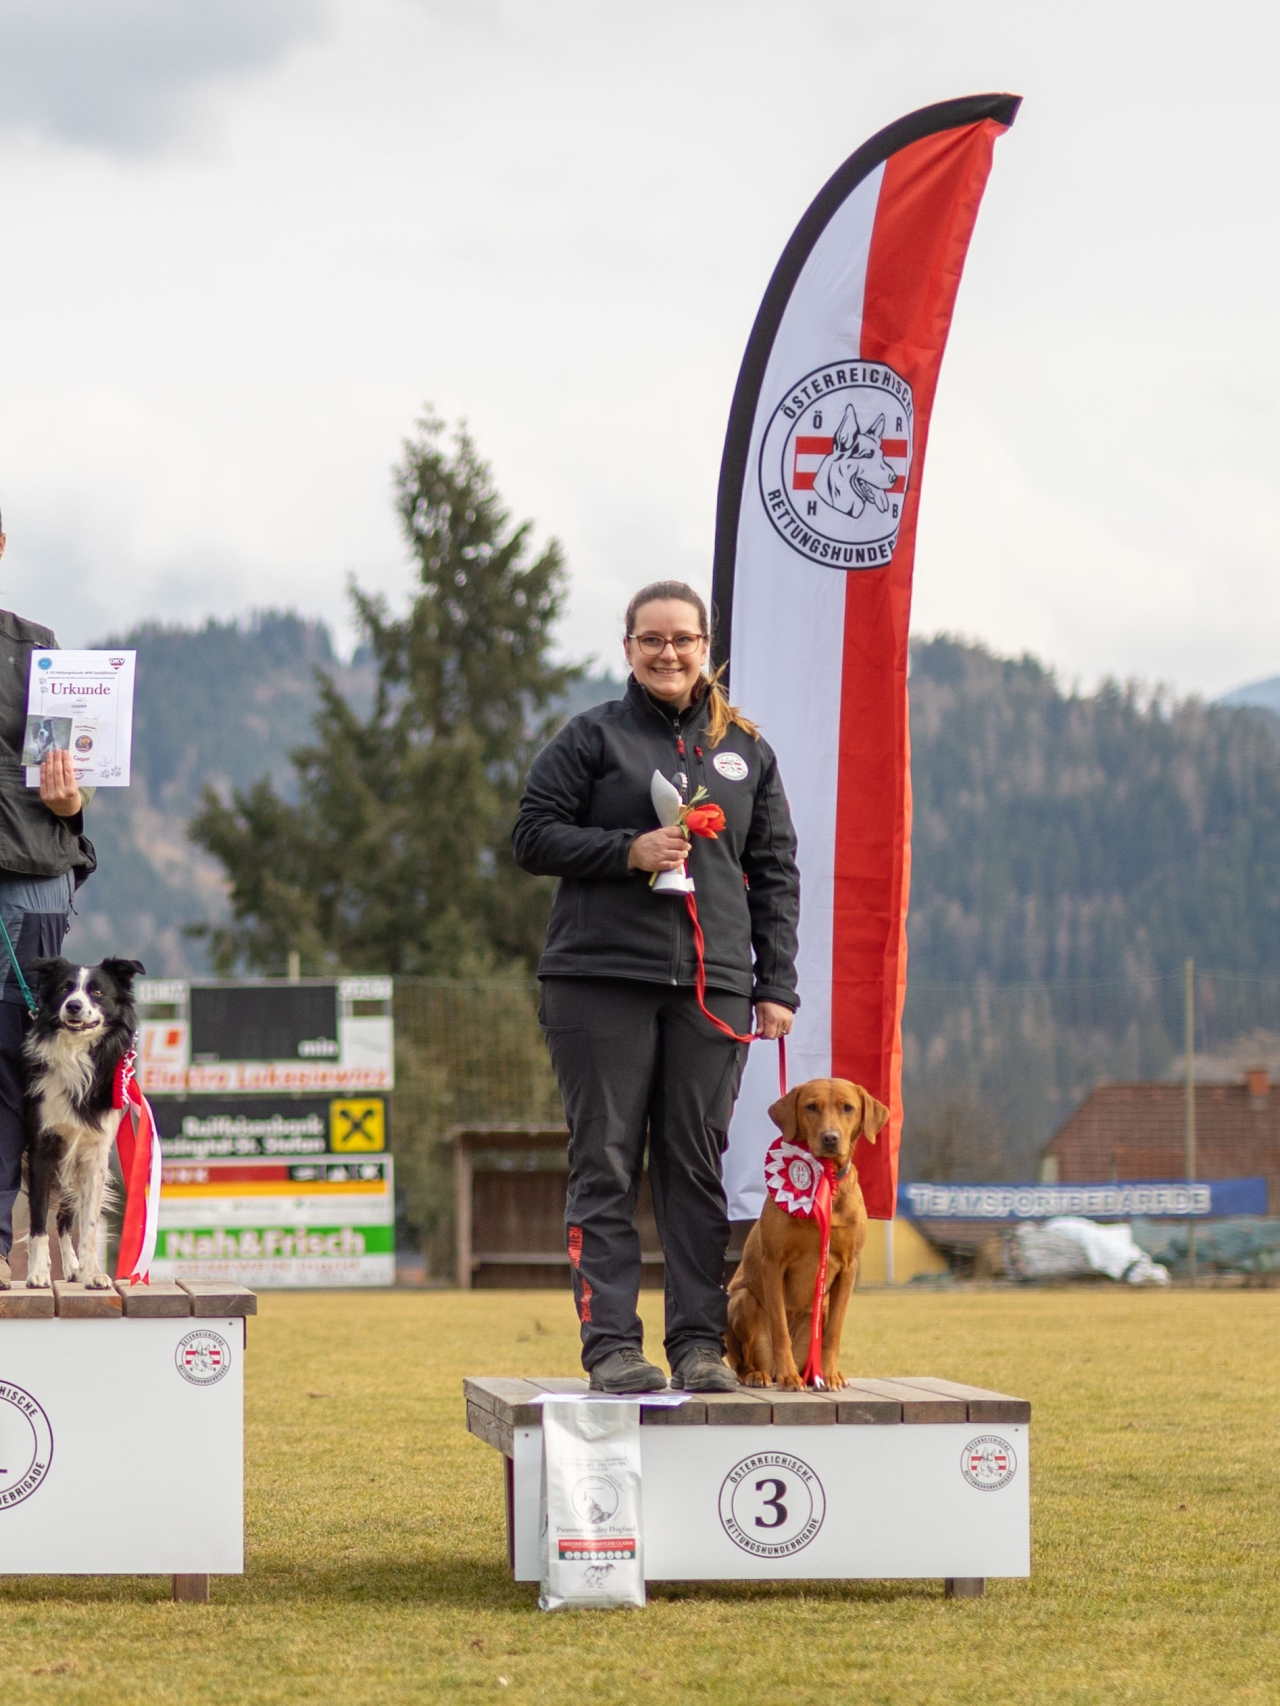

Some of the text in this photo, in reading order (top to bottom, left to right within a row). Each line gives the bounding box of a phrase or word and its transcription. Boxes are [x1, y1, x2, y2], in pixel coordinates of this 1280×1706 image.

[896, 417, 902, 432] R
[807, 501, 899, 517] H B
[767, 489, 899, 563] RETTUNGSHUNDE
[51, 682, 111, 695] Urkunde
[143, 1067, 228, 1088] Elektro
[182, 1114, 325, 1136] Raiffeisenbank
[164, 1228, 366, 1258] Nah&Frisch
[728, 1455, 814, 1484] ÖSTERREICHISCHE
[754, 1478, 788, 1528] 3
[609, 1525, 636, 1534] Dogfood
[725, 1518, 819, 1555] RETTUNGSHUNDEBRIGADE
